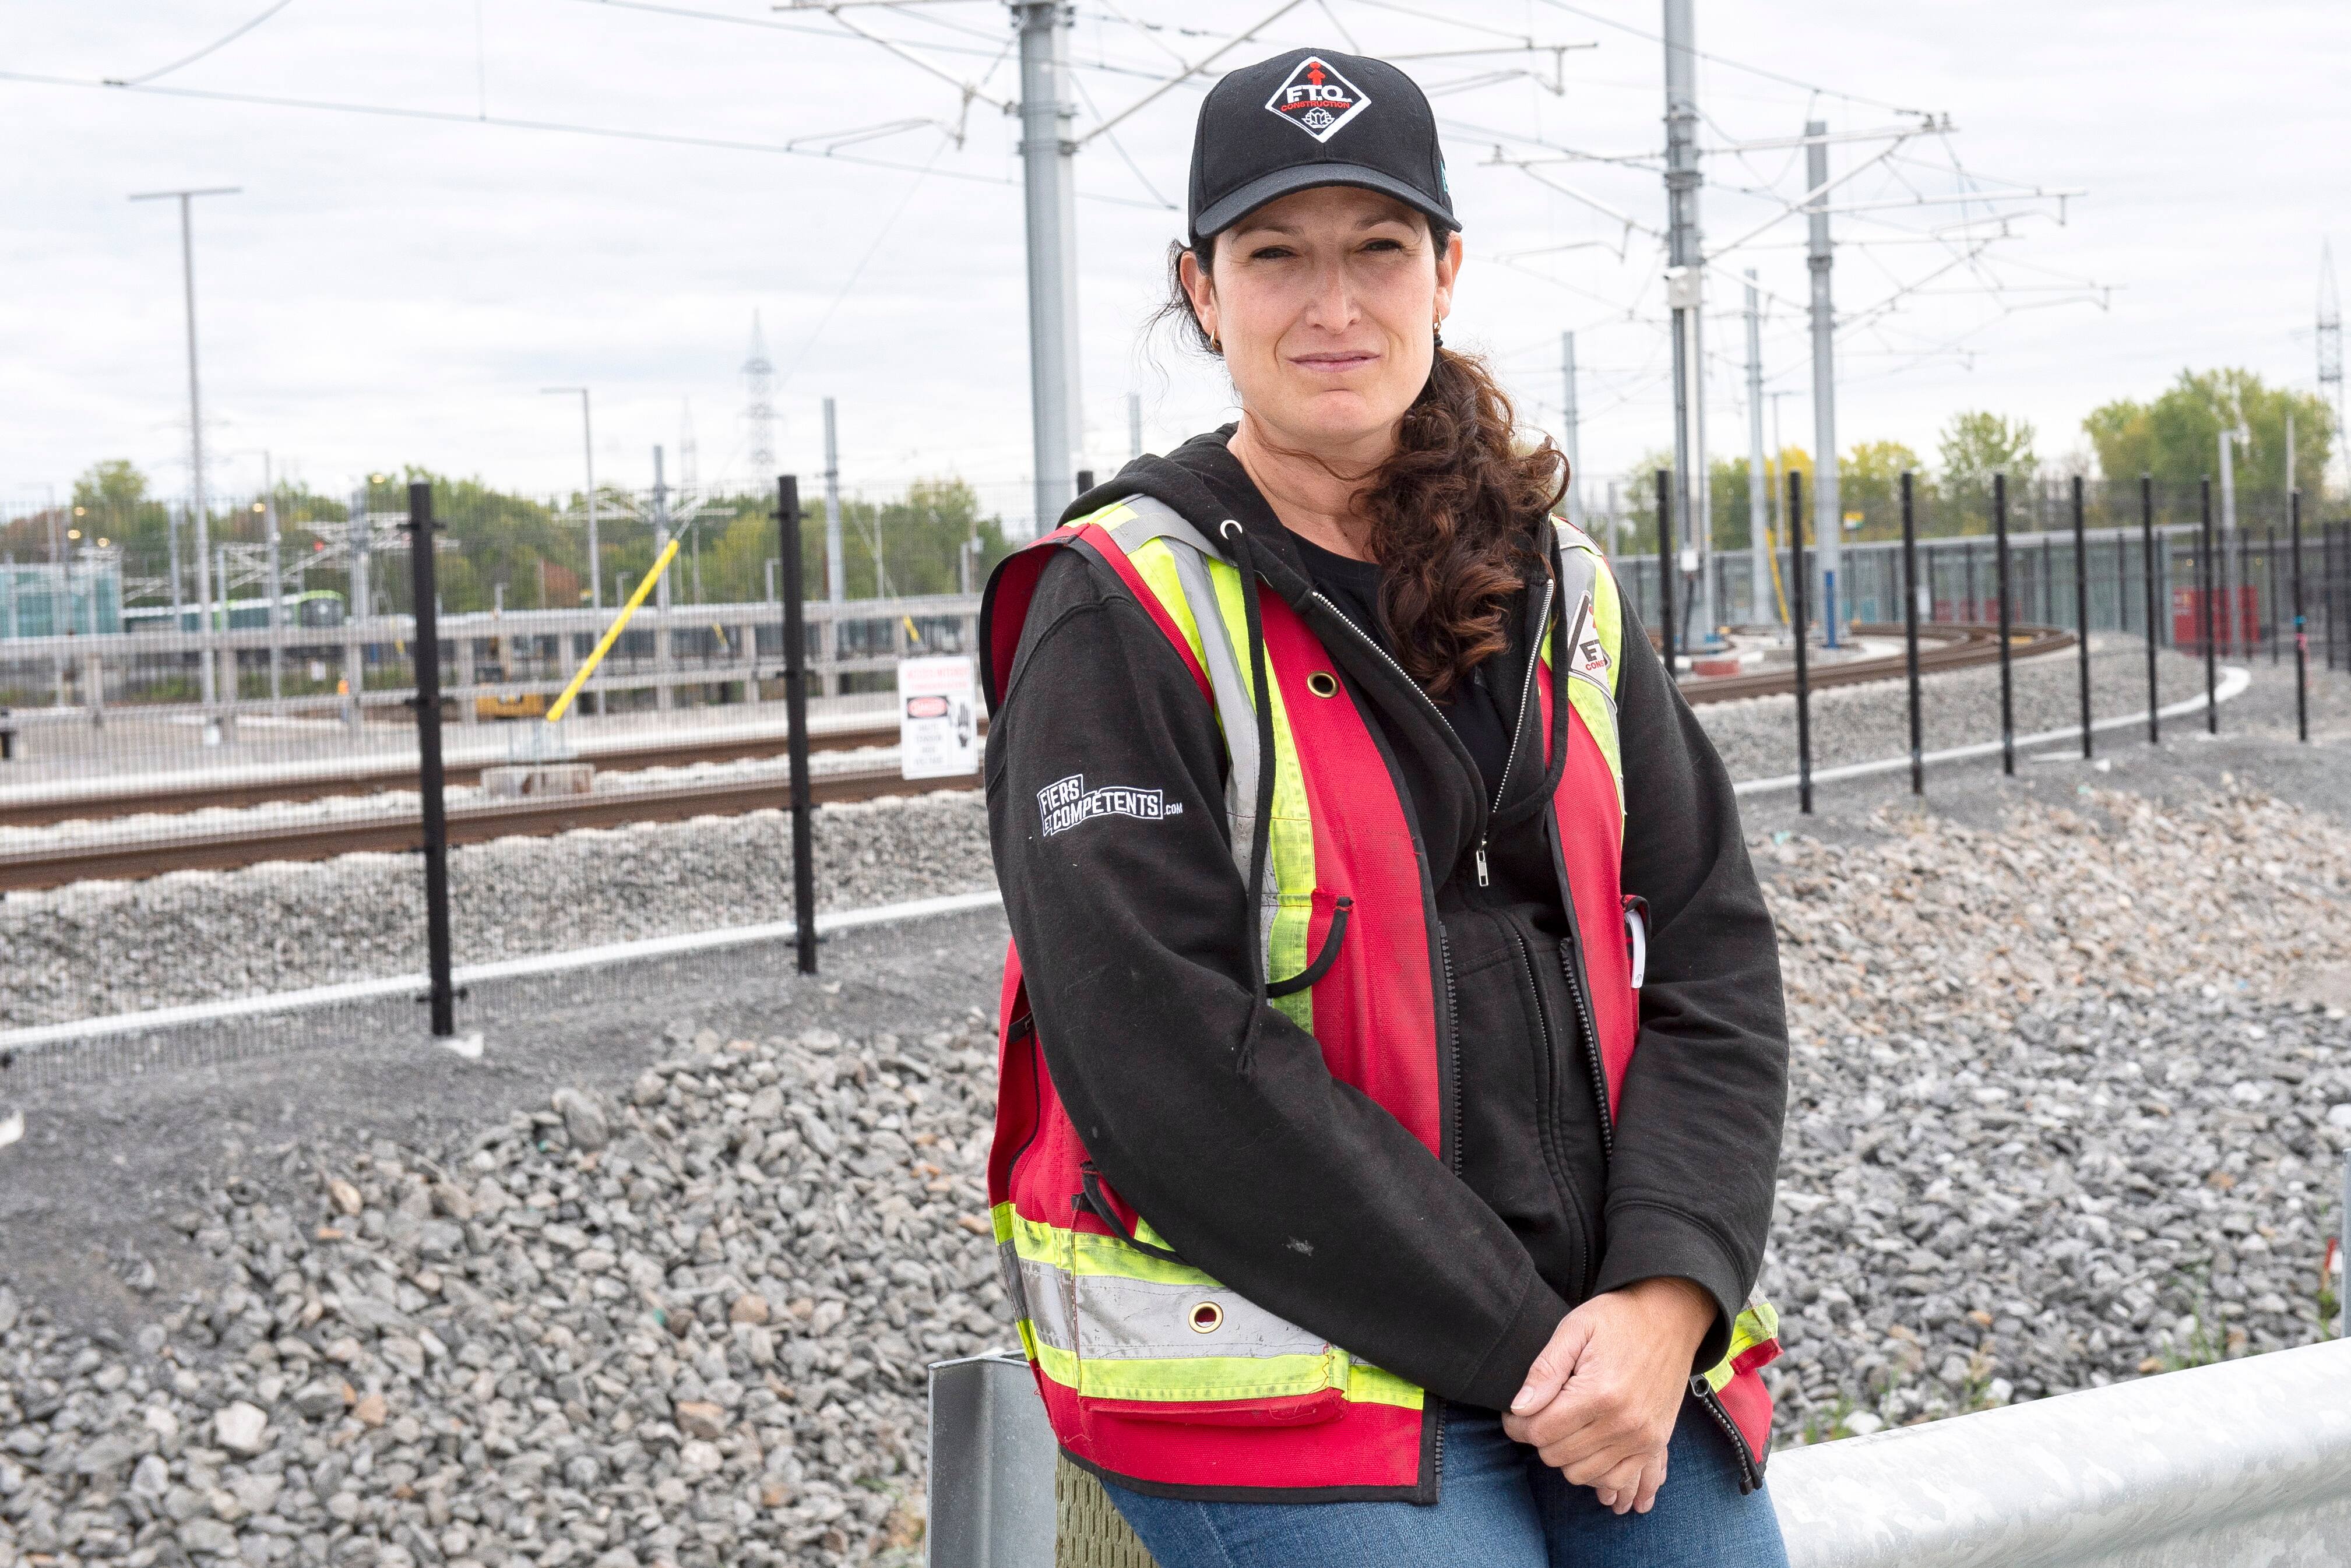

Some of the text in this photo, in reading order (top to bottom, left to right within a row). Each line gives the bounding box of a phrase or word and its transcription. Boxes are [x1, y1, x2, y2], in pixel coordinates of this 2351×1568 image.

[1280, 100, 1350, 112] CONSTRUCTION
[1040, 779, 1079, 816] FIERS
[1044, 814, 1053, 831] ET
